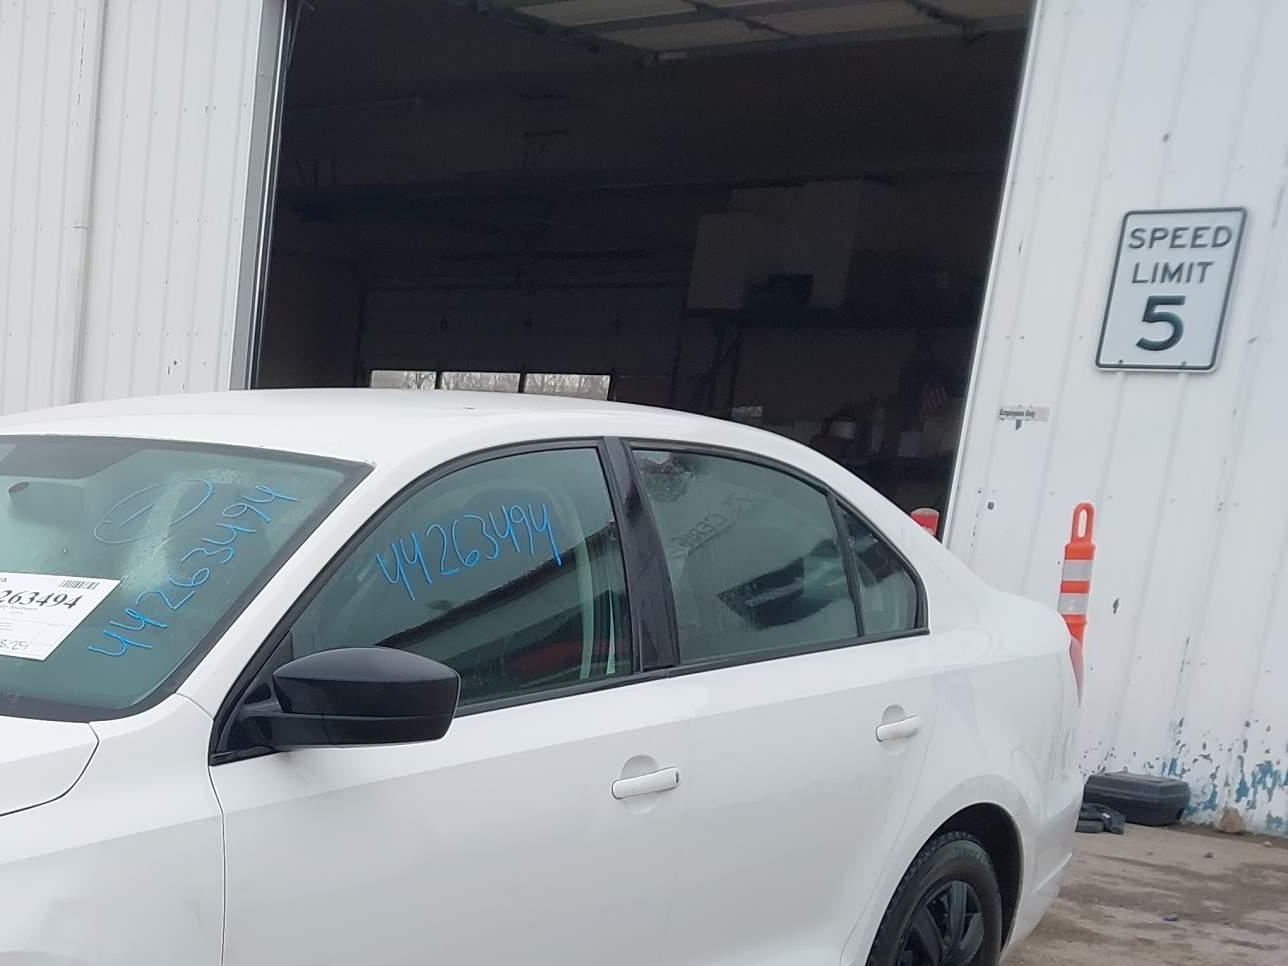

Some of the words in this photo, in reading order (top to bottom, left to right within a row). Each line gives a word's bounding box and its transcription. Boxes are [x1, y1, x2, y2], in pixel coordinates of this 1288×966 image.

[1128, 225, 1233, 249] SPEED
[1131, 261, 1215, 284] LIMIT
[1135, 295, 1186, 352] 5
[88, 484, 298, 657] 44263494
[375, 503, 562, 601] 44263494
